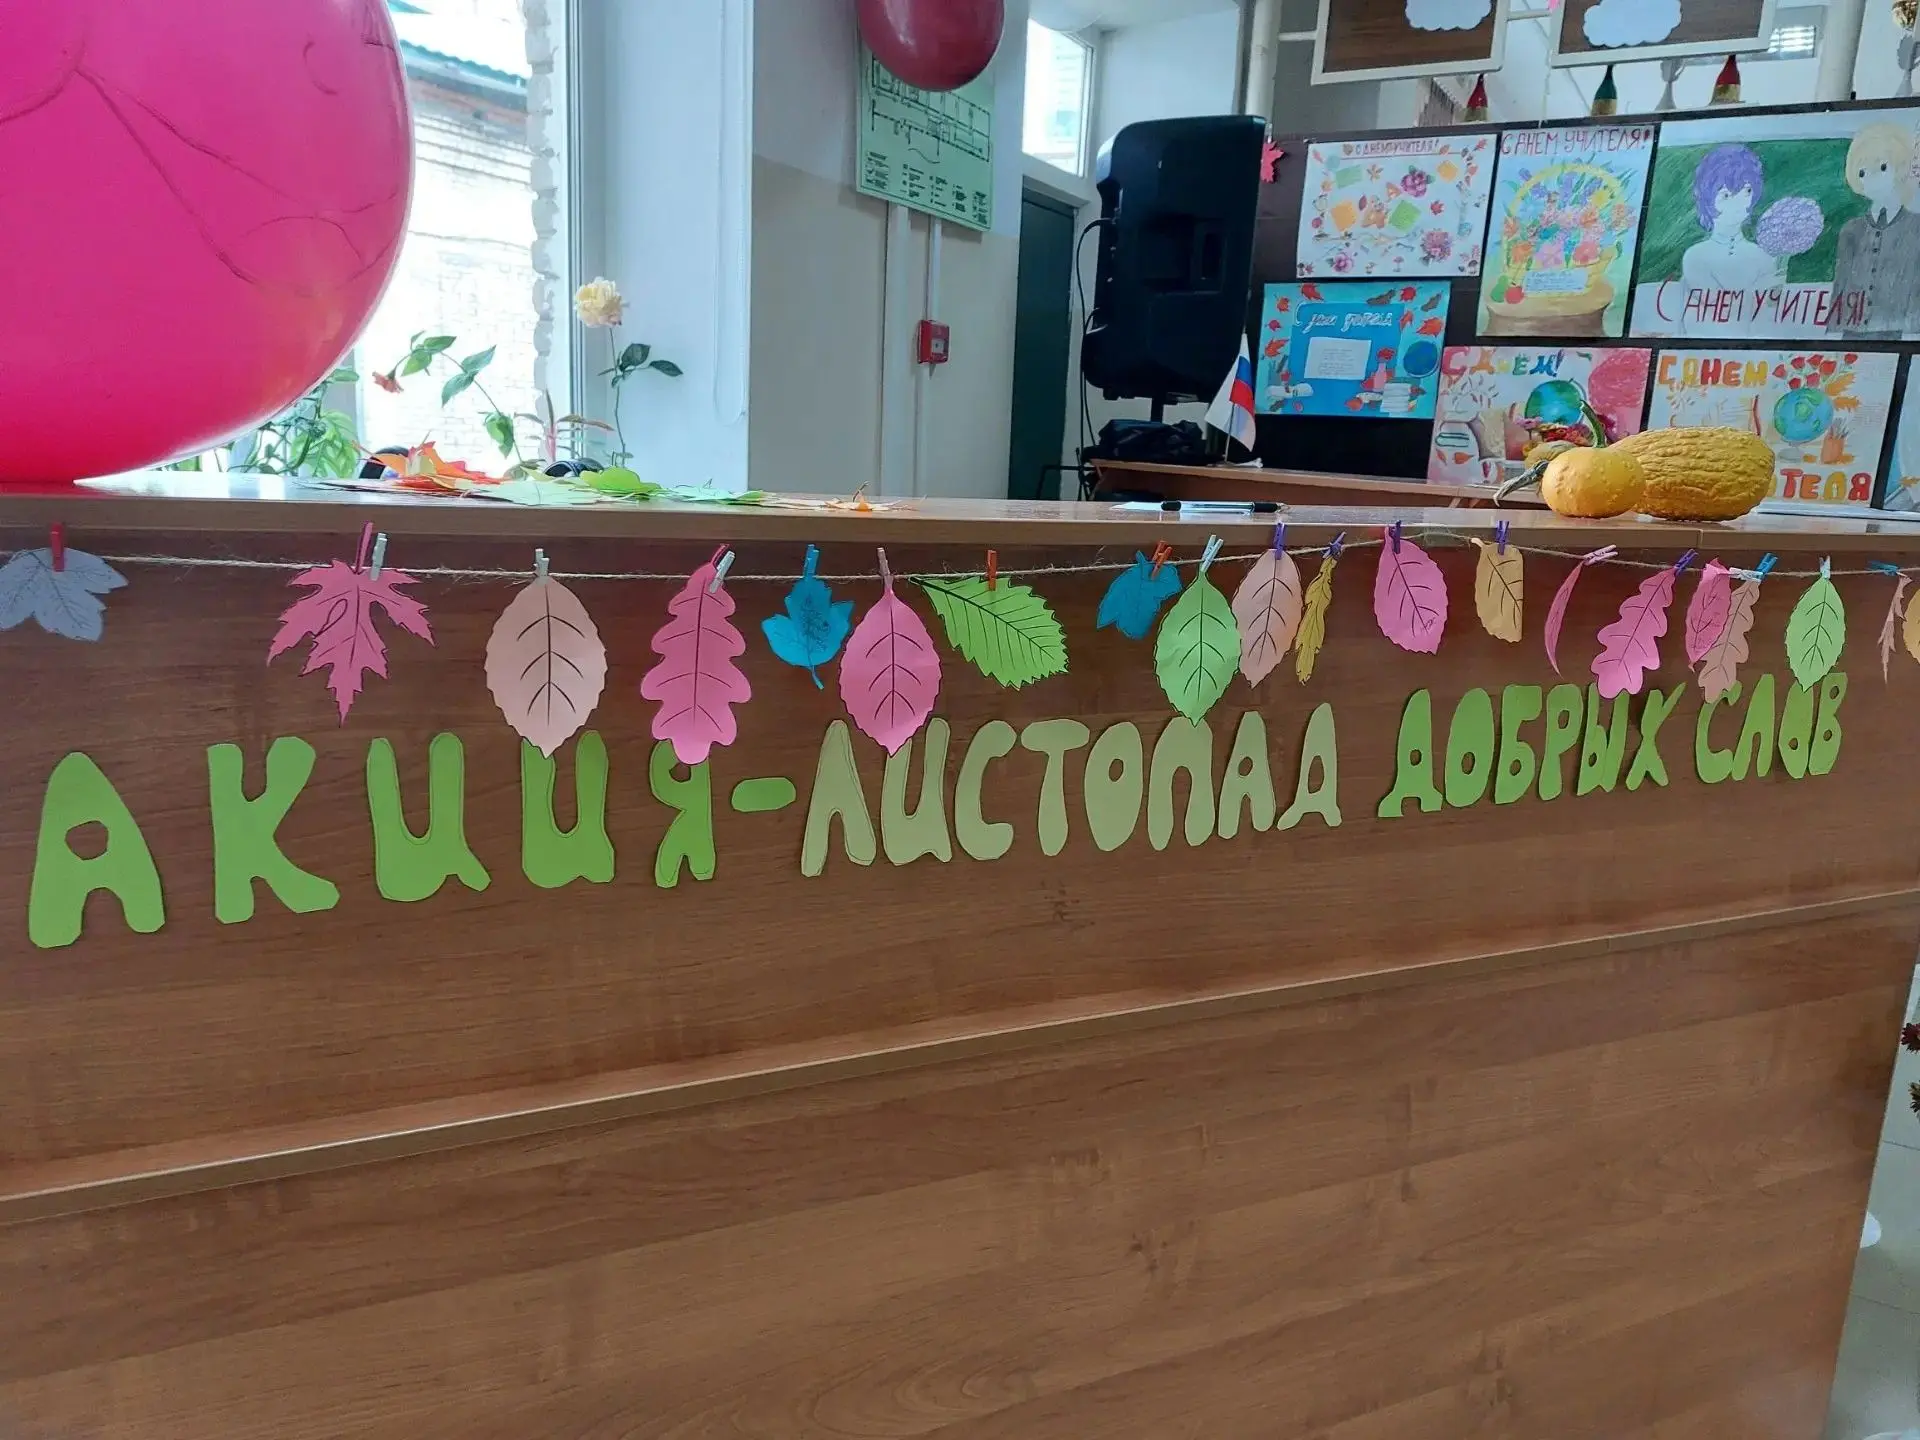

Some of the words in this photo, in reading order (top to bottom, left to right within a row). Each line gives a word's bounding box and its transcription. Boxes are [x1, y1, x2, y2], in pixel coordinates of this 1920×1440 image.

[1751, 290, 1868, 326] УЧИТЕЛЯ!
[1378, 683, 1685, 818] ДОБРЫХ
[1695, 673, 1848, 784] СЛОВ
